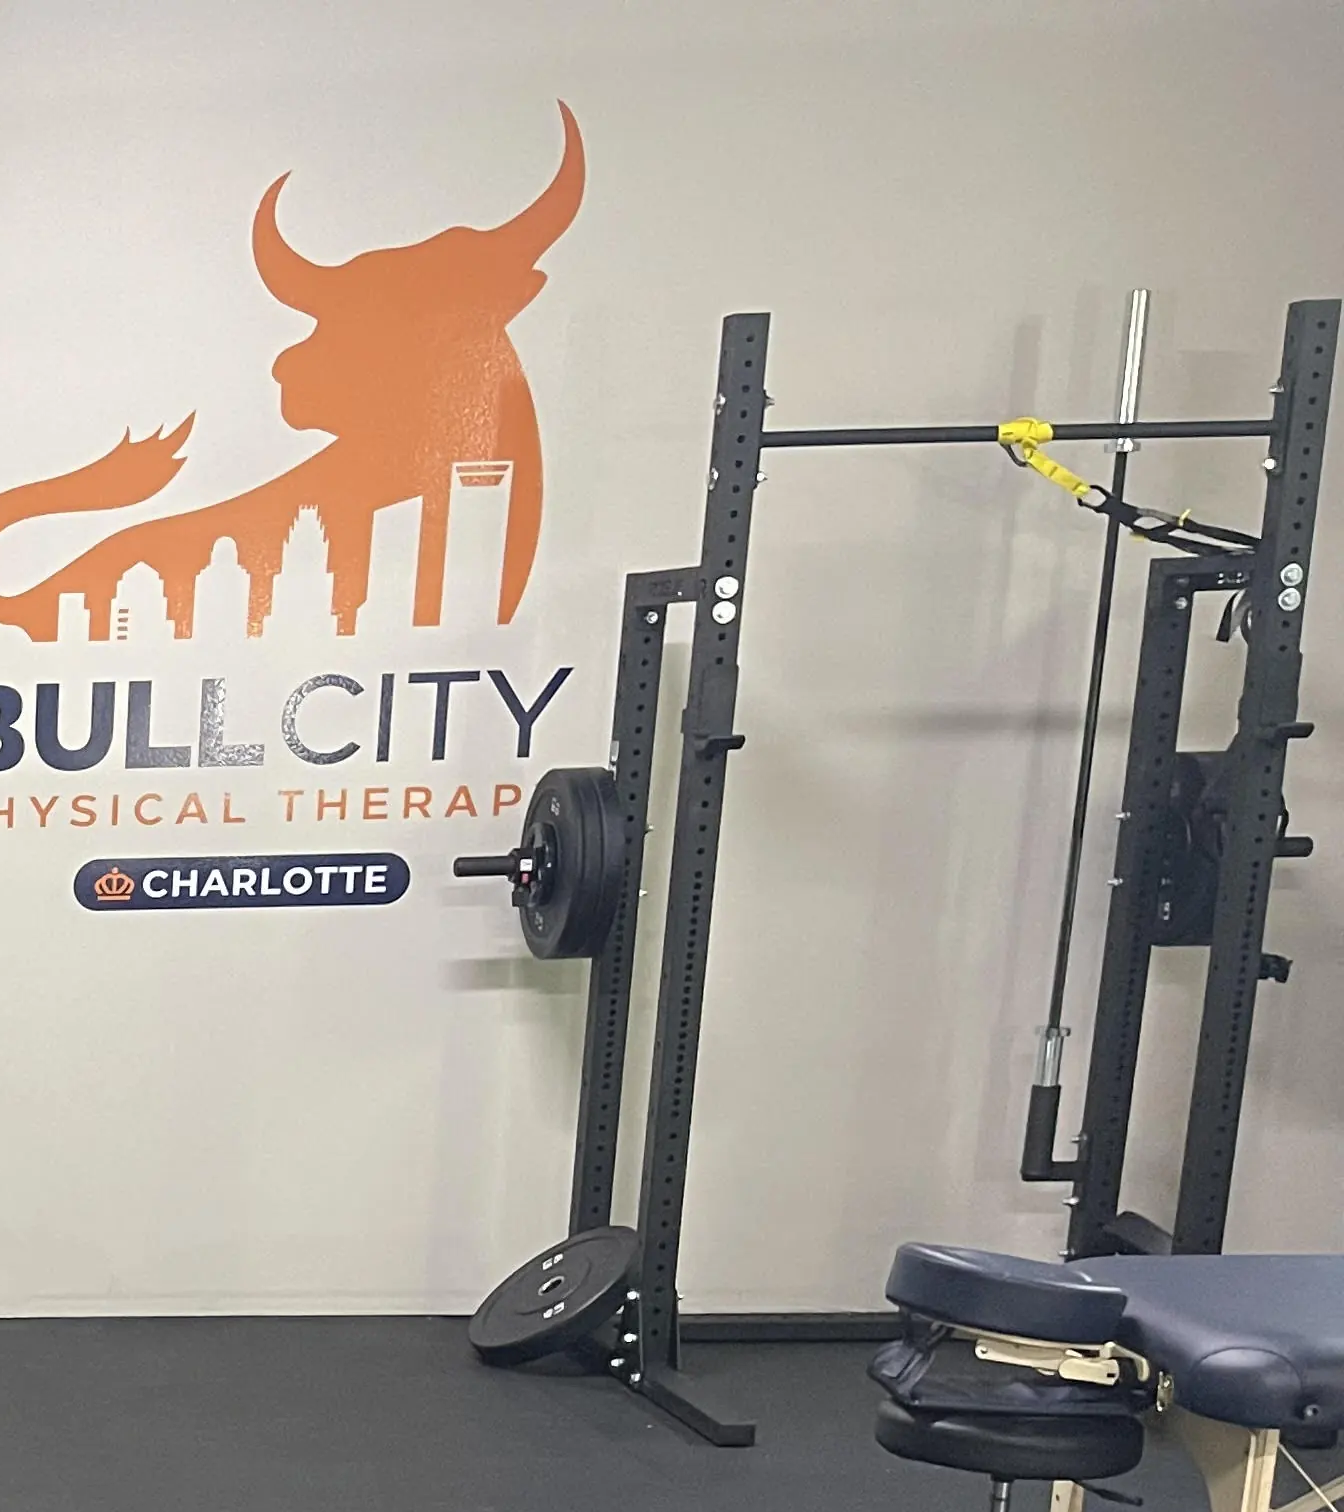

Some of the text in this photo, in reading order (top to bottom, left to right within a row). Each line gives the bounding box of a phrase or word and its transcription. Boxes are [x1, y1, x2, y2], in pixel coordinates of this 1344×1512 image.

[281, 667, 575, 766] CITY
[277, 783, 523, 823] THERAP
[142, 864, 388, 899] CHARLOTTE
